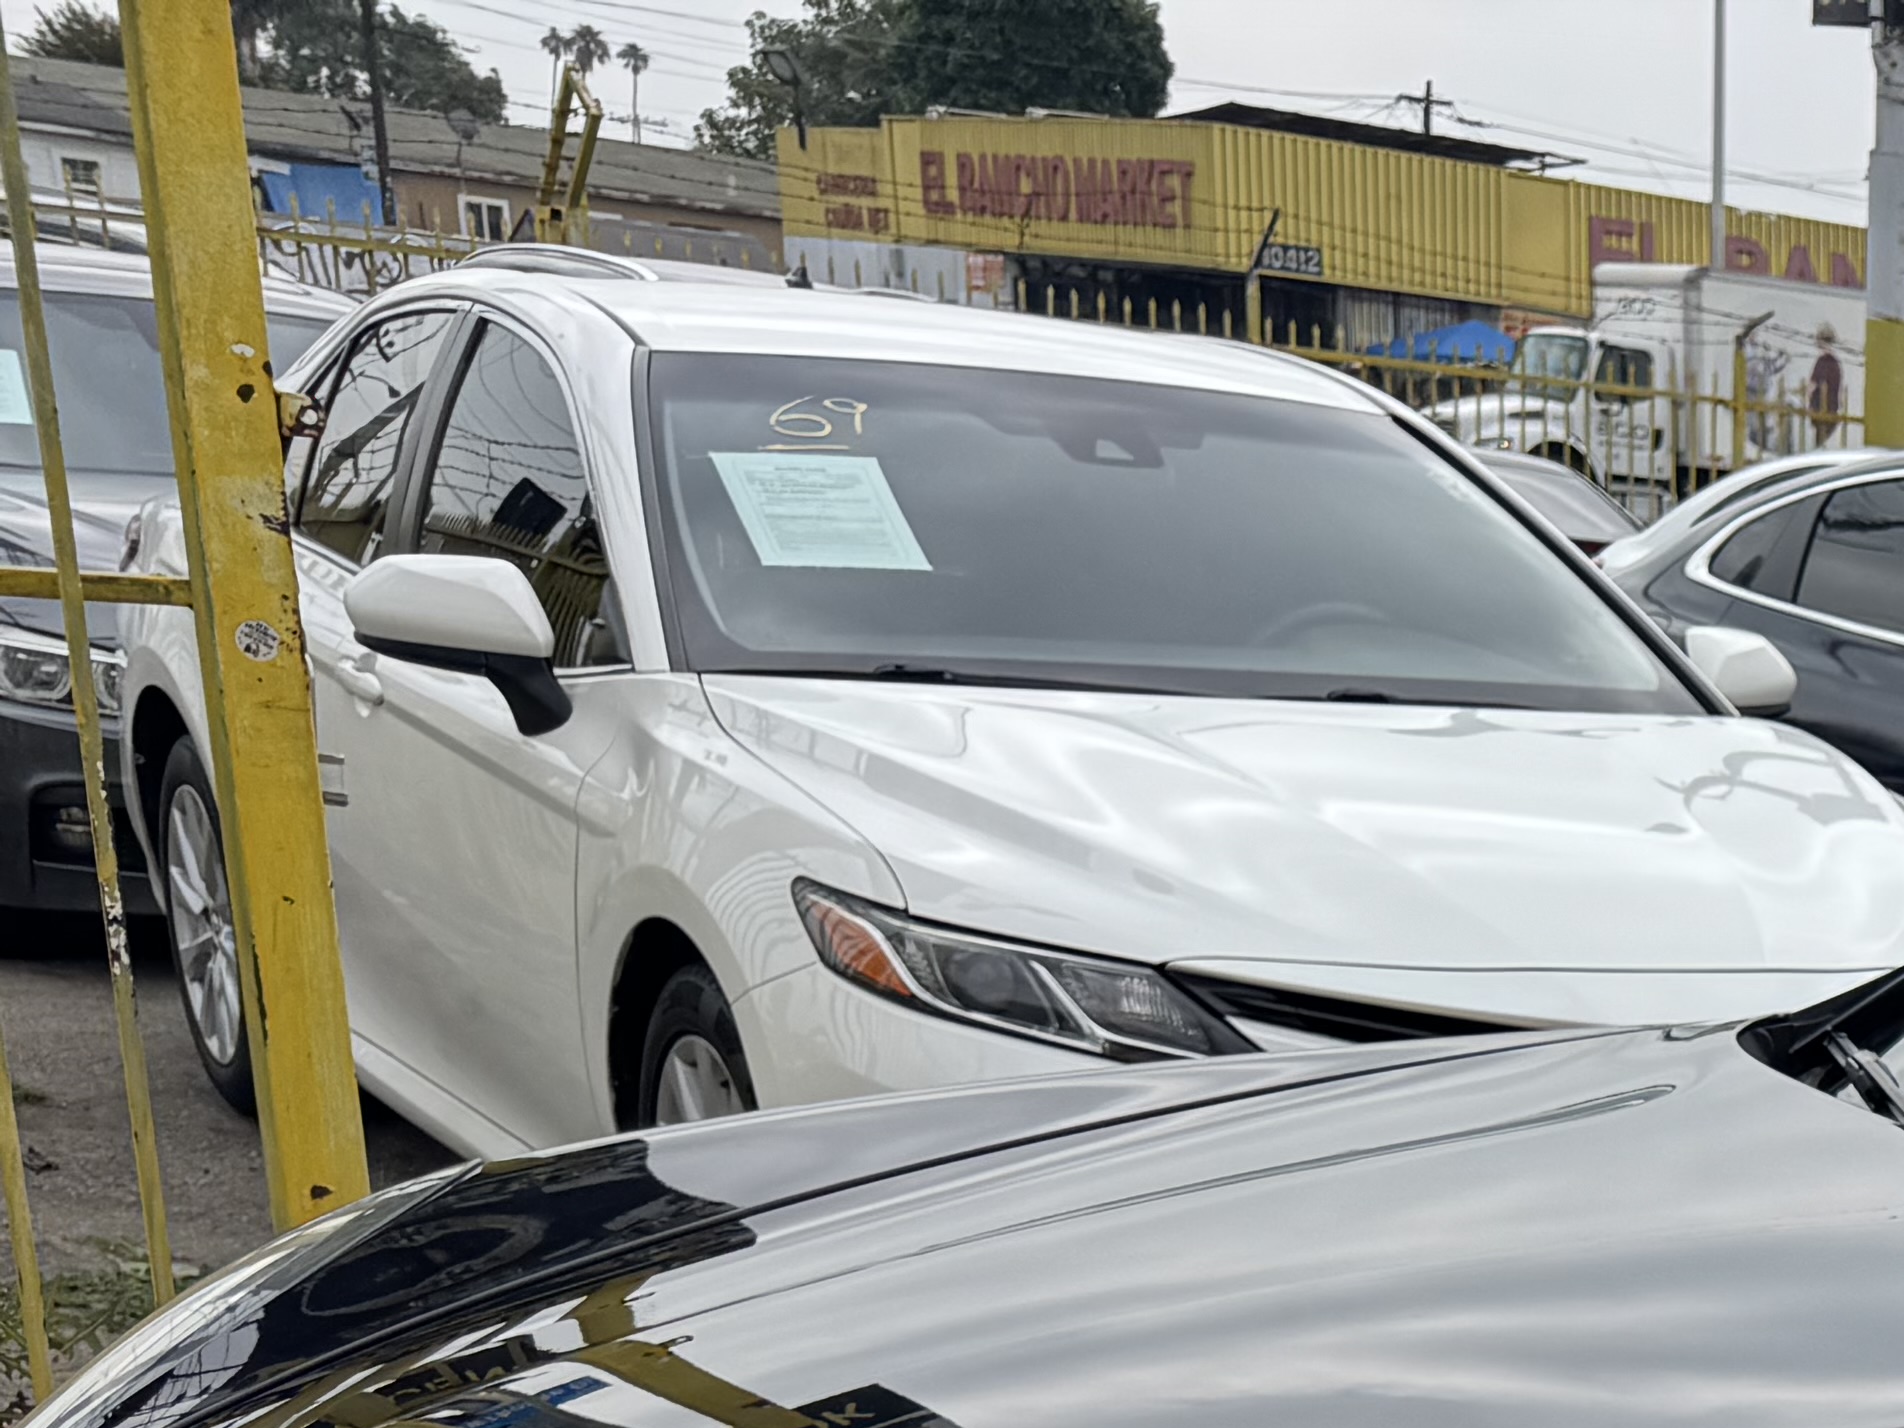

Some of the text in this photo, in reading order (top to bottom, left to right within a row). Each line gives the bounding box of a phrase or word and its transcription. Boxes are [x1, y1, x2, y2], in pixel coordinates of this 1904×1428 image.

[920, 151, 957, 216] EL
[956, 152, 1071, 223] RANCHO
[1071, 157, 1196, 229] MARKET
[768, 396, 868, 438] 69
